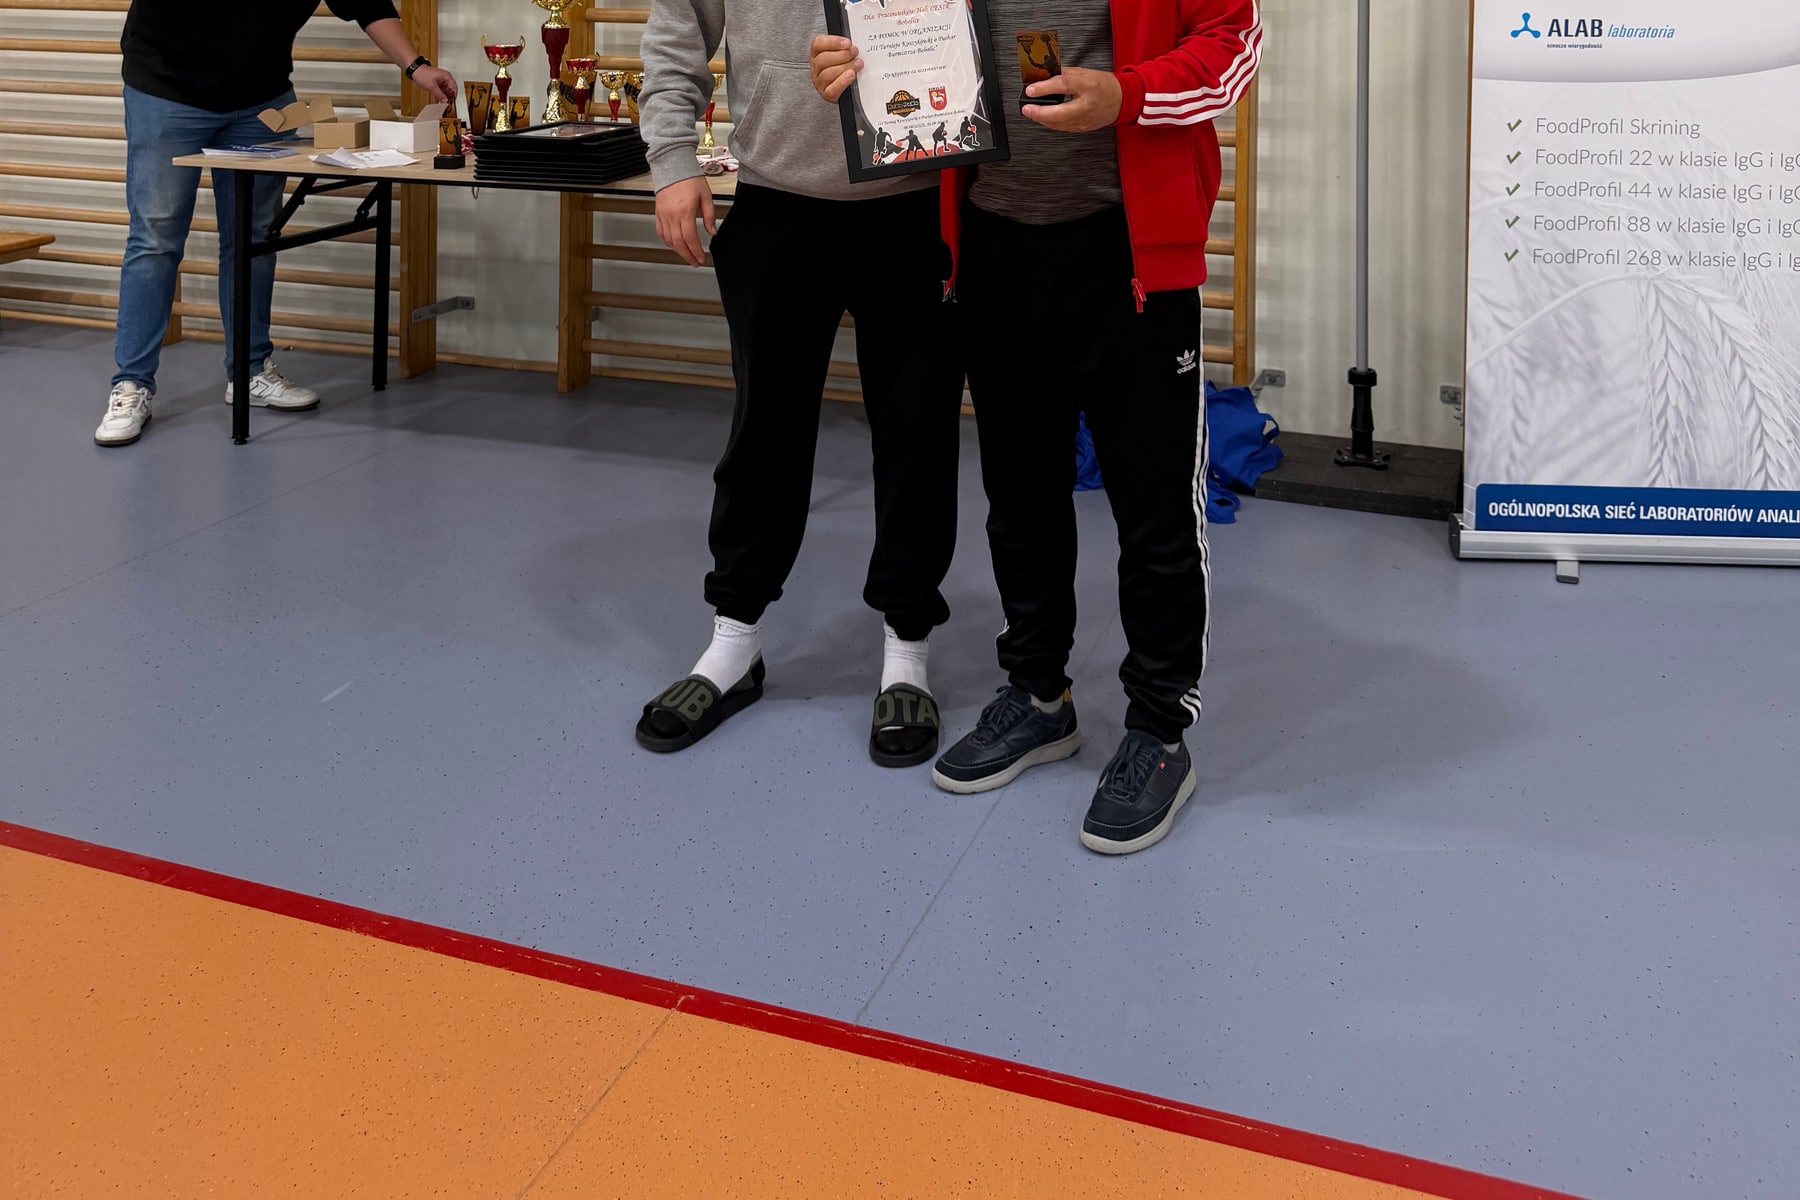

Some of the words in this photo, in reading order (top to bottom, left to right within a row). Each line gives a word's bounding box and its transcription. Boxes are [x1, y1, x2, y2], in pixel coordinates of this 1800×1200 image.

[1547, 18, 1603, 38] ALAB
[1607, 24, 1676, 38] laboratoria
[1536, 118, 1624, 134] FoodProfil
[1630, 118, 1700, 139] Skrining
[1535, 149, 1623, 165] FoodProfil
[1629, 150, 1653, 166] 22
[1658, 154, 1674, 166] w
[1680, 151, 1728, 167] klasie
[1734, 151, 1763, 171] IgG
[1769, 152, 1773, 168] i
[1534, 181, 1622, 197] FoodProfil
[1628, 182, 1652, 198] 44
[1657, 187, 1673, 198] w
[1679, 183, 1727, 199] klasie
[1733, 184, 1762, 204] IgG
[1768, 184, 1772, 200] i
[1534, 215, 1621, 231] FoodProfil
[1627, 216, 1651, 232] 88
[1656, 220, 1672, 233] w
[1678, 217, 1725, 234] klasie
[1732, 218, 1761, 238] IgG
[1767, 218, 1771, 234] i
[1533, 248, 1620, 265] FoodProfil
[1626, 249, 1662, 266] 268
[1667, 254, 1683, 266] w
[1688, 250, 1736, 267] klasie
[1743, 251, 1772, 271] IgG
[1778, 252, 1782, 268] i
[1176, 361, 1196, 374] adidas
[1488, 499, 1601, 519] OGÓLNOPOLSKA
[1604, 501, 1636, 519] SIEĆ
[1639, 504, 1753, 523] LABORATORIÓW
[1756, 509, 1800, 524] ANALI
[652, 680, 714, 721] UB
[873, 691, 939, 729] OTA
